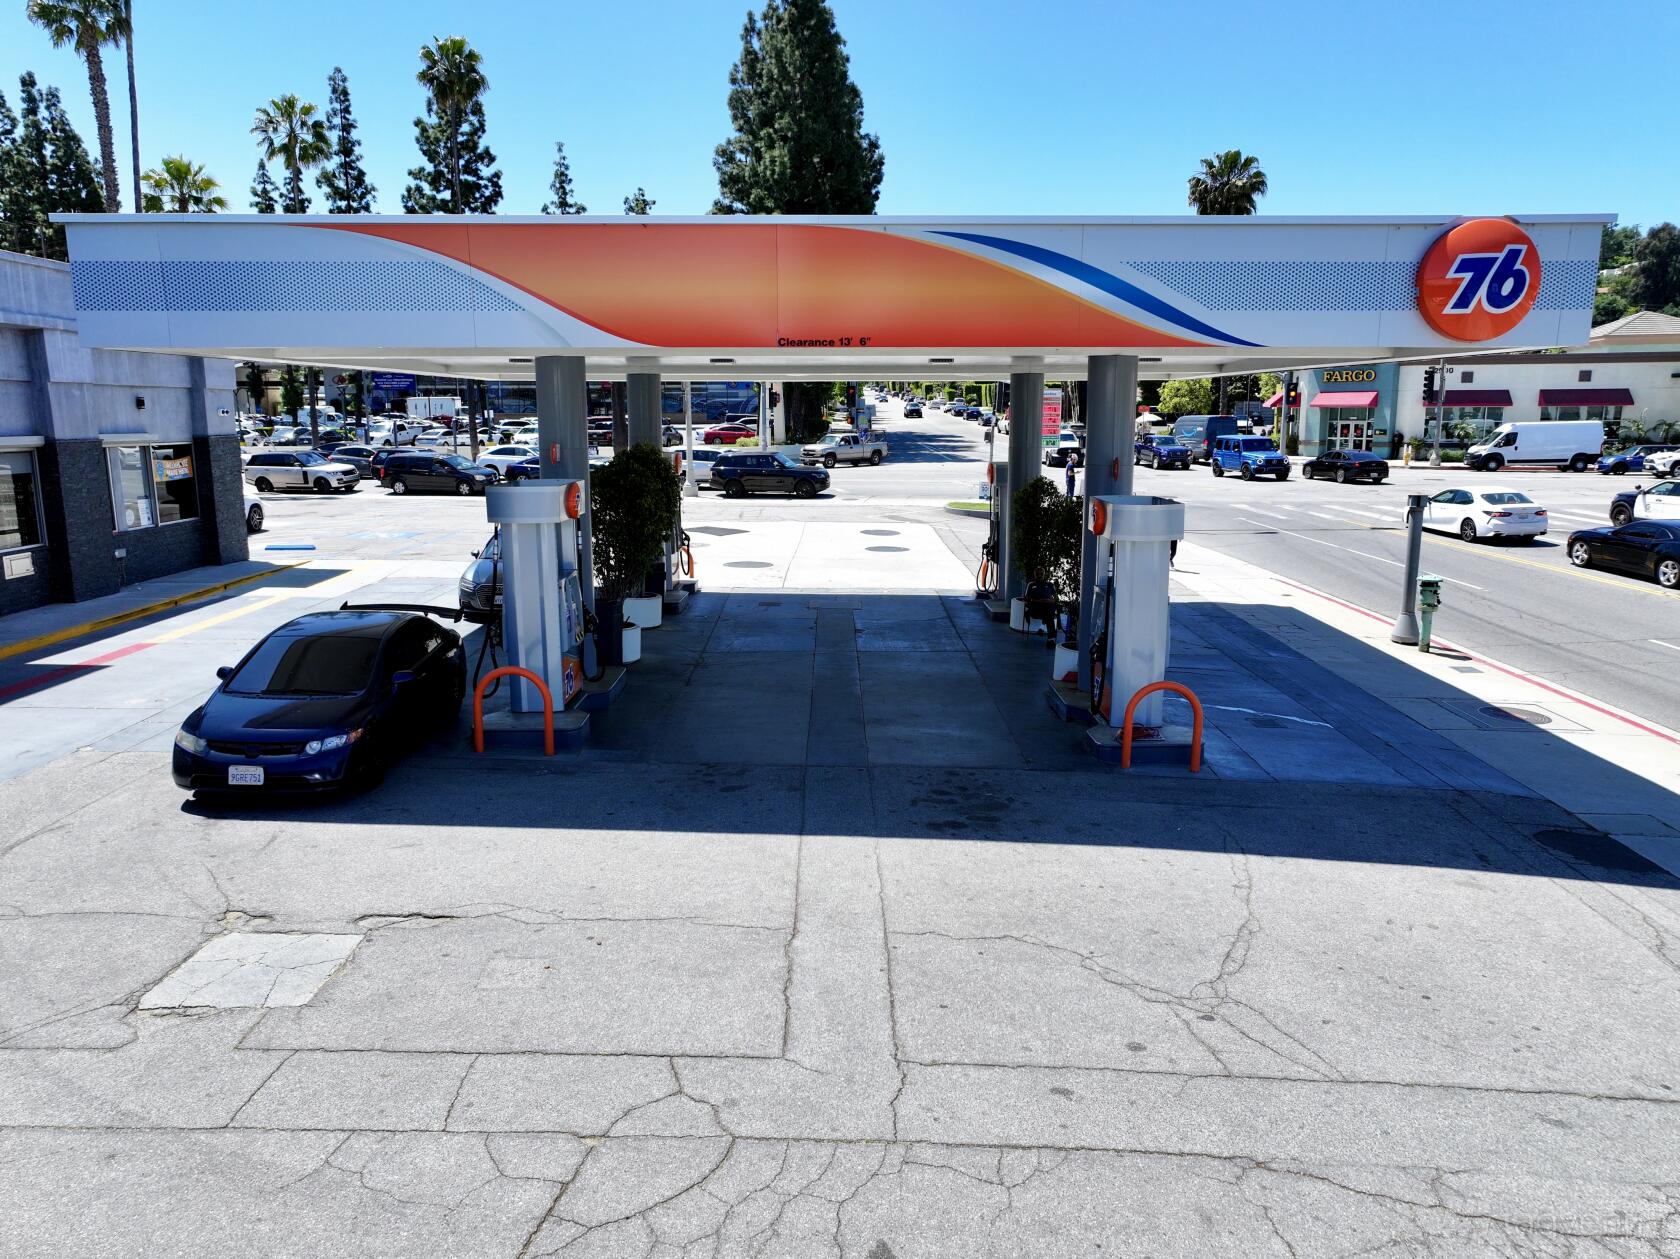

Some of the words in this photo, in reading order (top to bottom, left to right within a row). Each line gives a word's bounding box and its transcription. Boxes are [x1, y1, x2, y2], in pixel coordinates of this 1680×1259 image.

[1441, 244, 1530, 315] 76
[778, 337, 835, 347] Clearance
[839, 337, 853, 347] 13'
[1323, 370, 1376, 383] FARGO
[231, 773, 261, 783] 9GRE751
